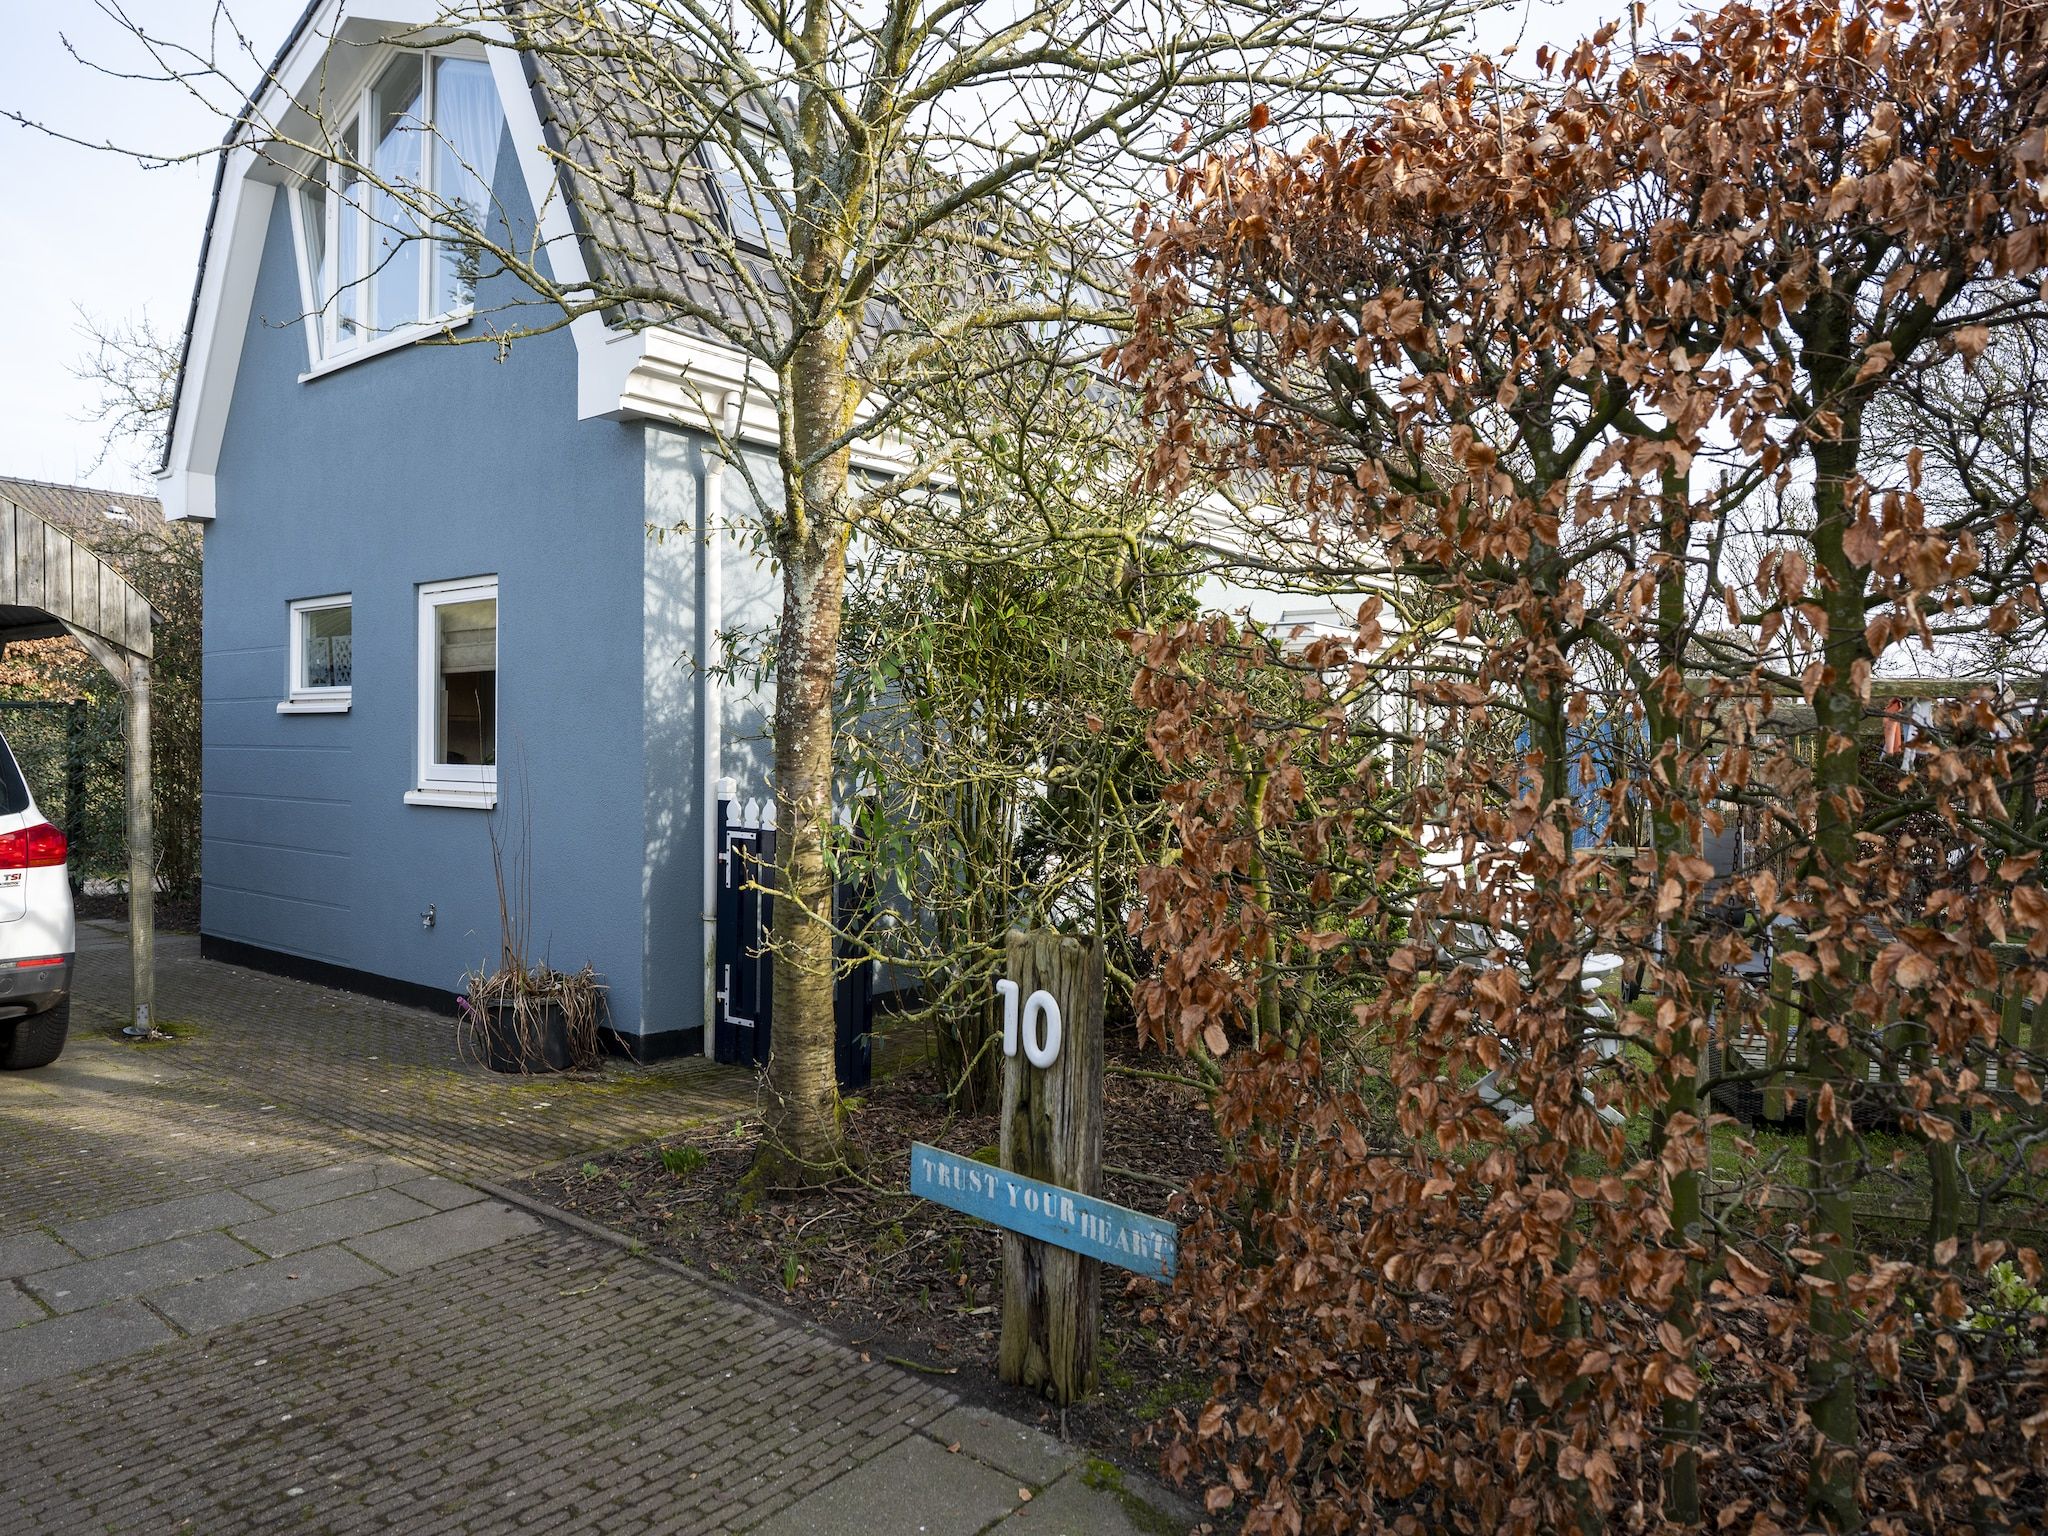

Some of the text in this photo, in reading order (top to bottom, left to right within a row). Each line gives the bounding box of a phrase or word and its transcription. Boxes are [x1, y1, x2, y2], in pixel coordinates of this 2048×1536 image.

[3, 873, 22, 881] TSI
[996, 979, 1062, 1069] 10
[922, 1158, 1169, 1261] TRUST YOUR HEART
